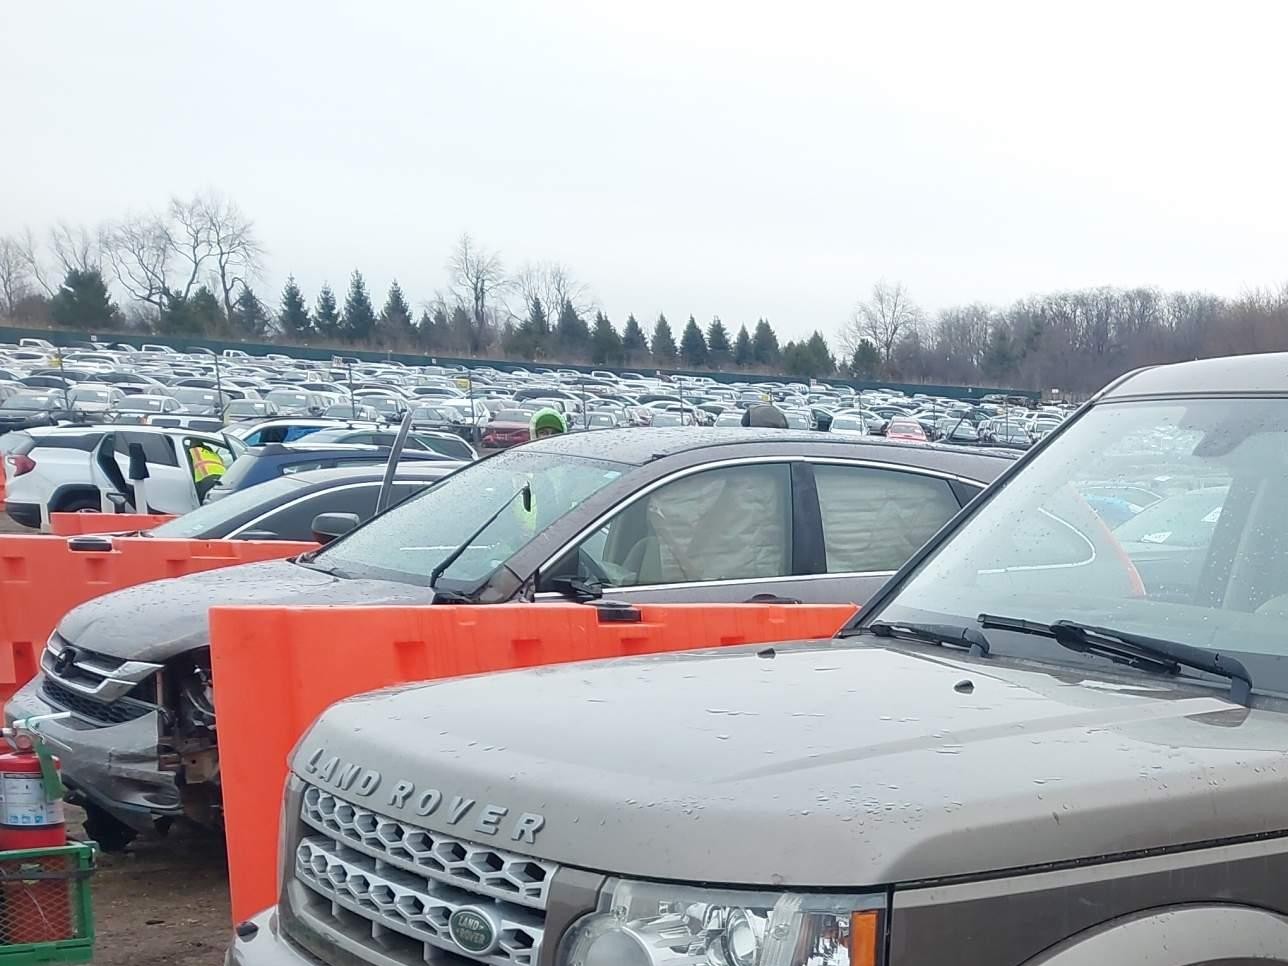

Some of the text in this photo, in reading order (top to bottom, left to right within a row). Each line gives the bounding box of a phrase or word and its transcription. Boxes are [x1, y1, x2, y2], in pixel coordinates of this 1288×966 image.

[305, 748, 545, 844] LAND ROVER
[458, 914, 480, 931] LAND
[459, 928, 486, 945] ROVER
